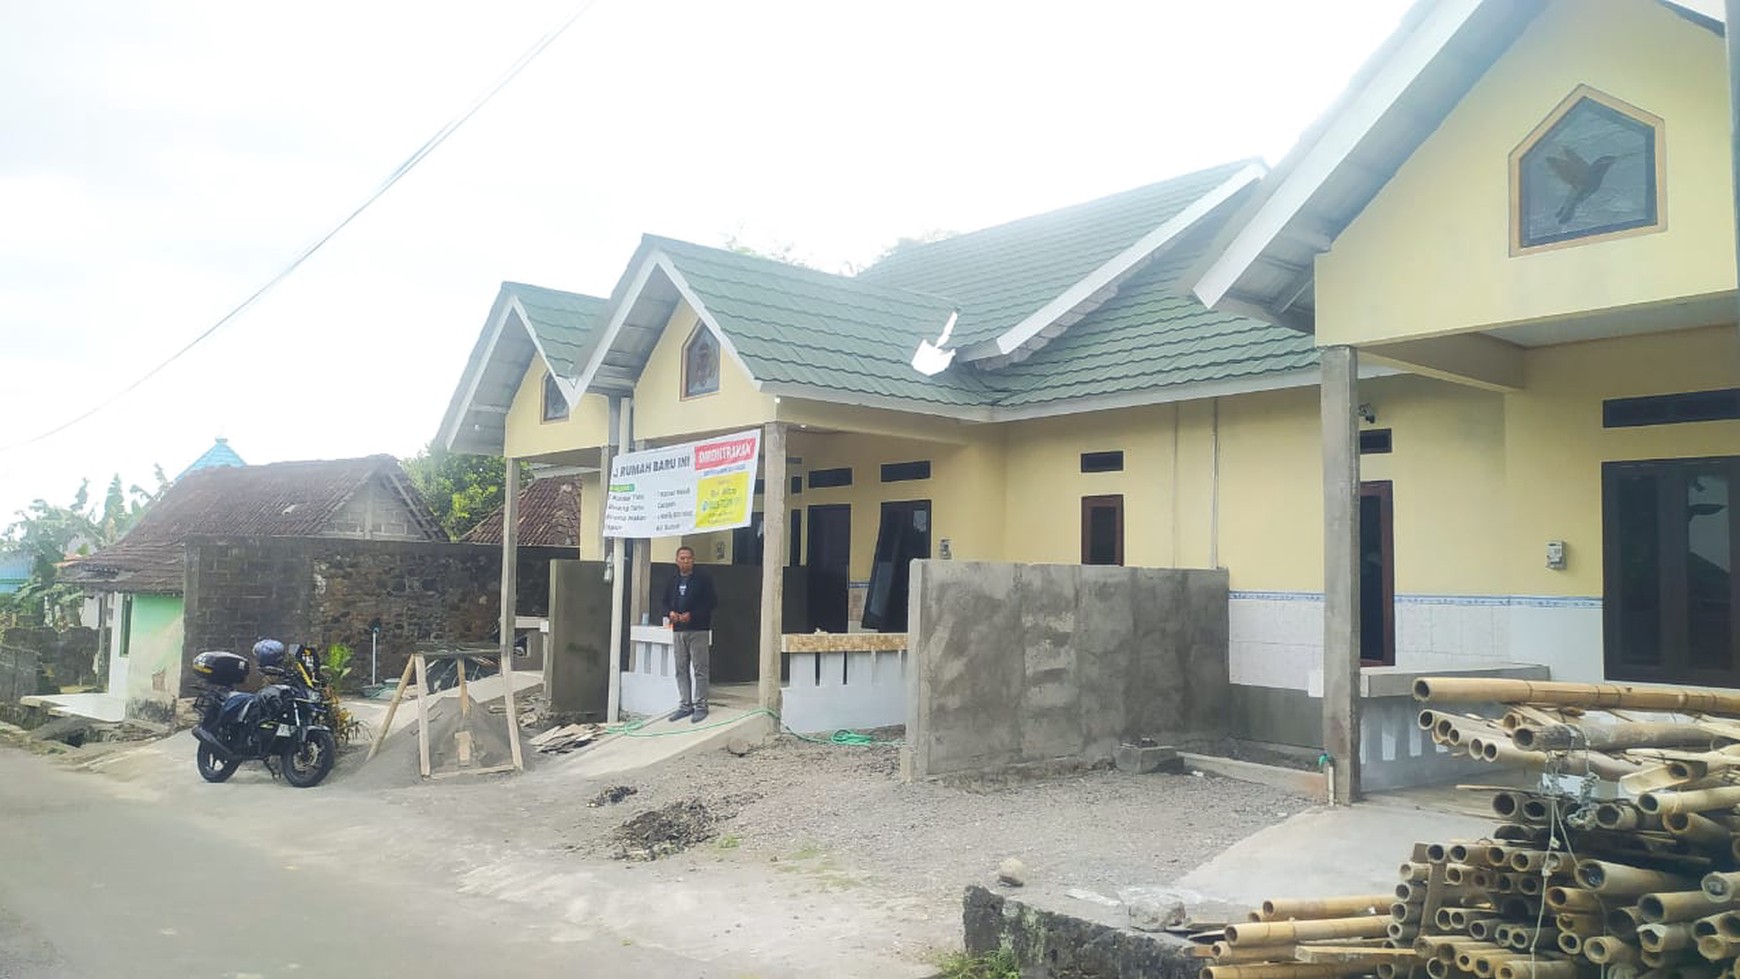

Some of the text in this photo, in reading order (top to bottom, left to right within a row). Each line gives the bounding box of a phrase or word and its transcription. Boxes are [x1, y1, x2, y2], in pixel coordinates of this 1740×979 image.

[620, 462, 651, 478] RUMAH
[653, 458, 676, 472] BARU
[677, 456, 690, 469] INI
